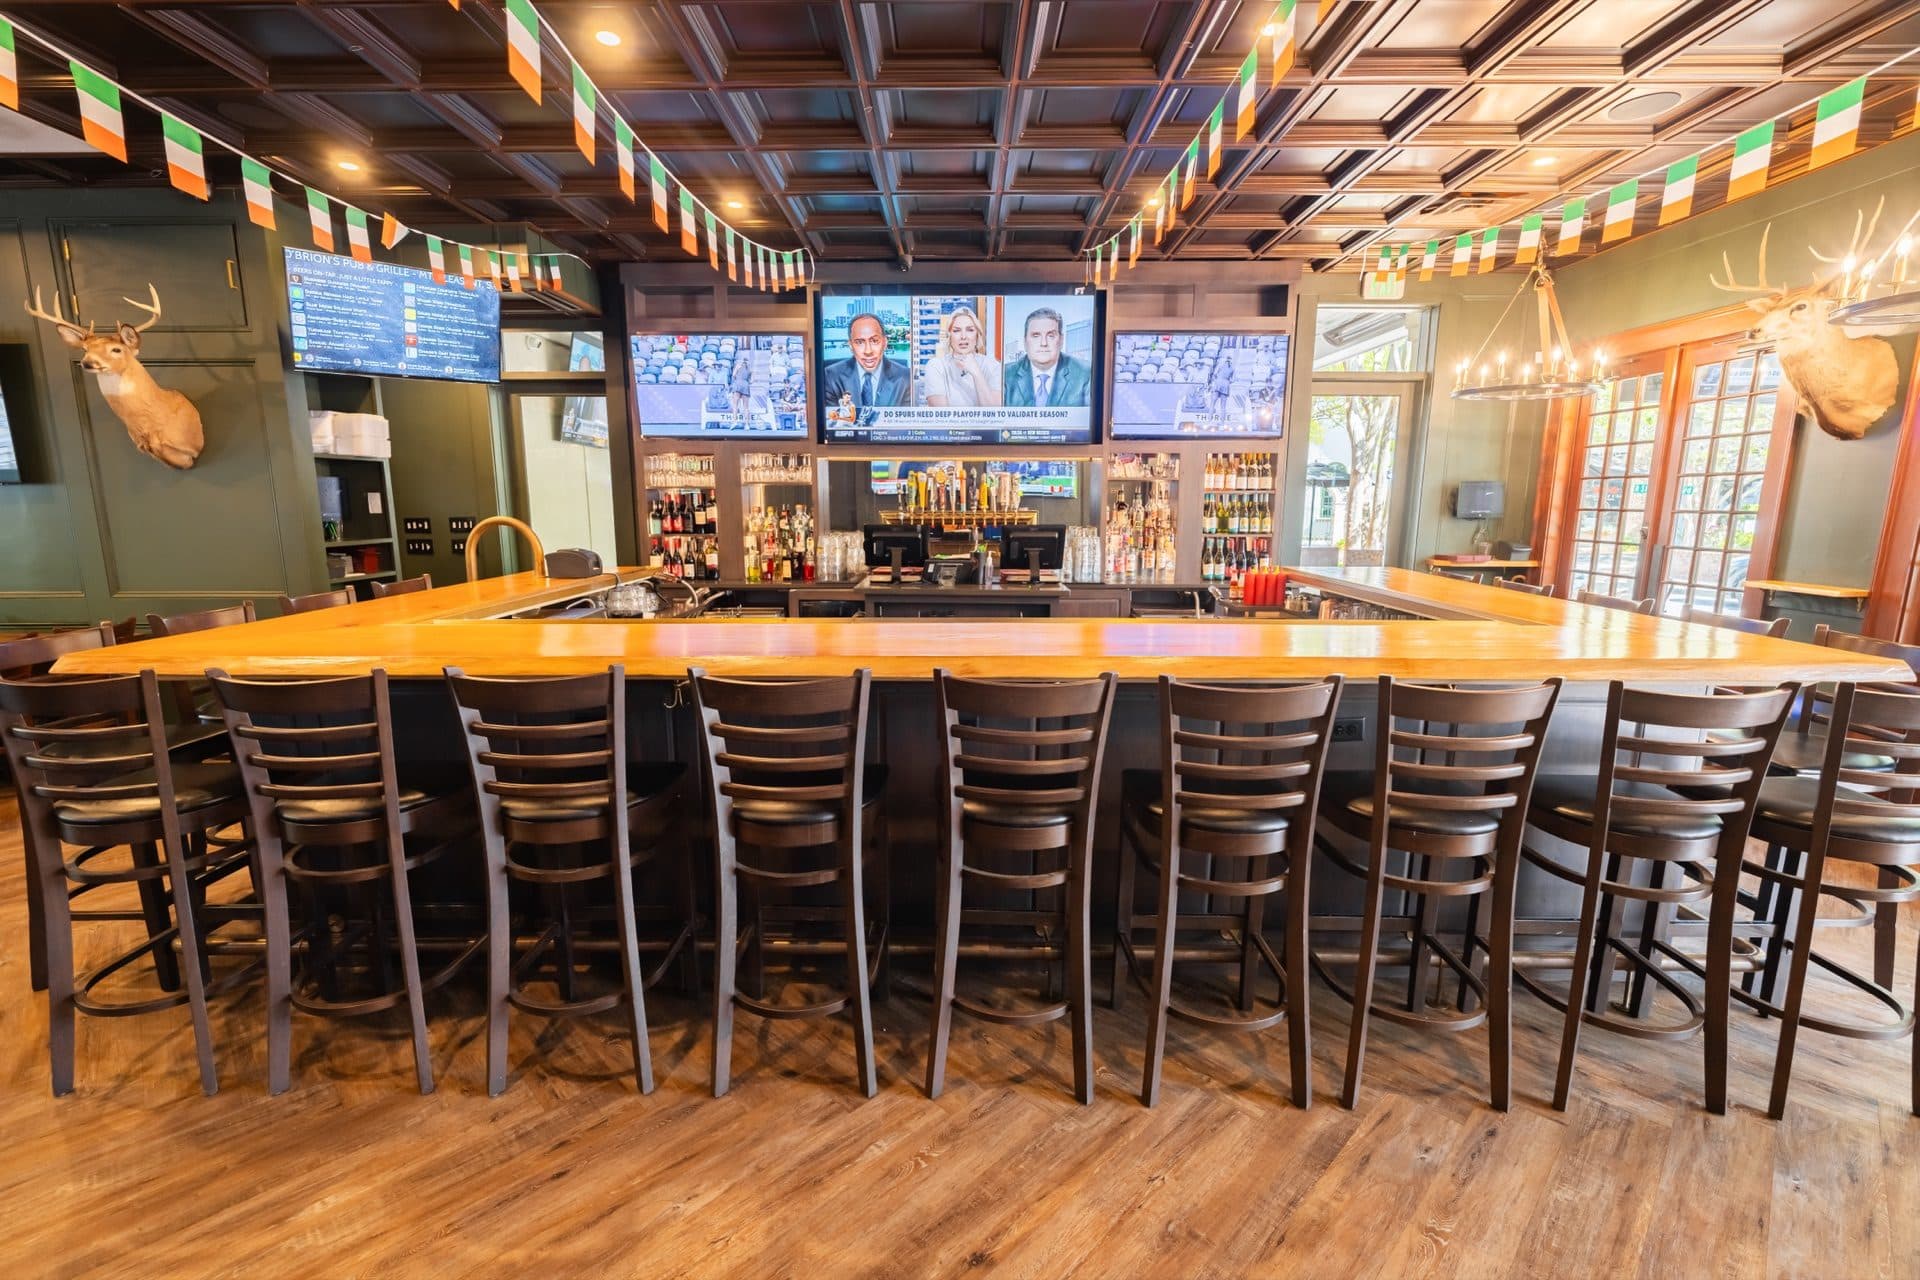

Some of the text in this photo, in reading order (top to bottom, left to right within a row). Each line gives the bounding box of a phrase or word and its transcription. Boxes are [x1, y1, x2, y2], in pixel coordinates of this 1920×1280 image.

[343, 259, 365, 270] PUB
[376, 264, 410, 276] GRILLE
[884, 410, 1069, 418] DO SPURS NEED DEEP PLAYOFF RUN TO VALIDATE SEASON?
